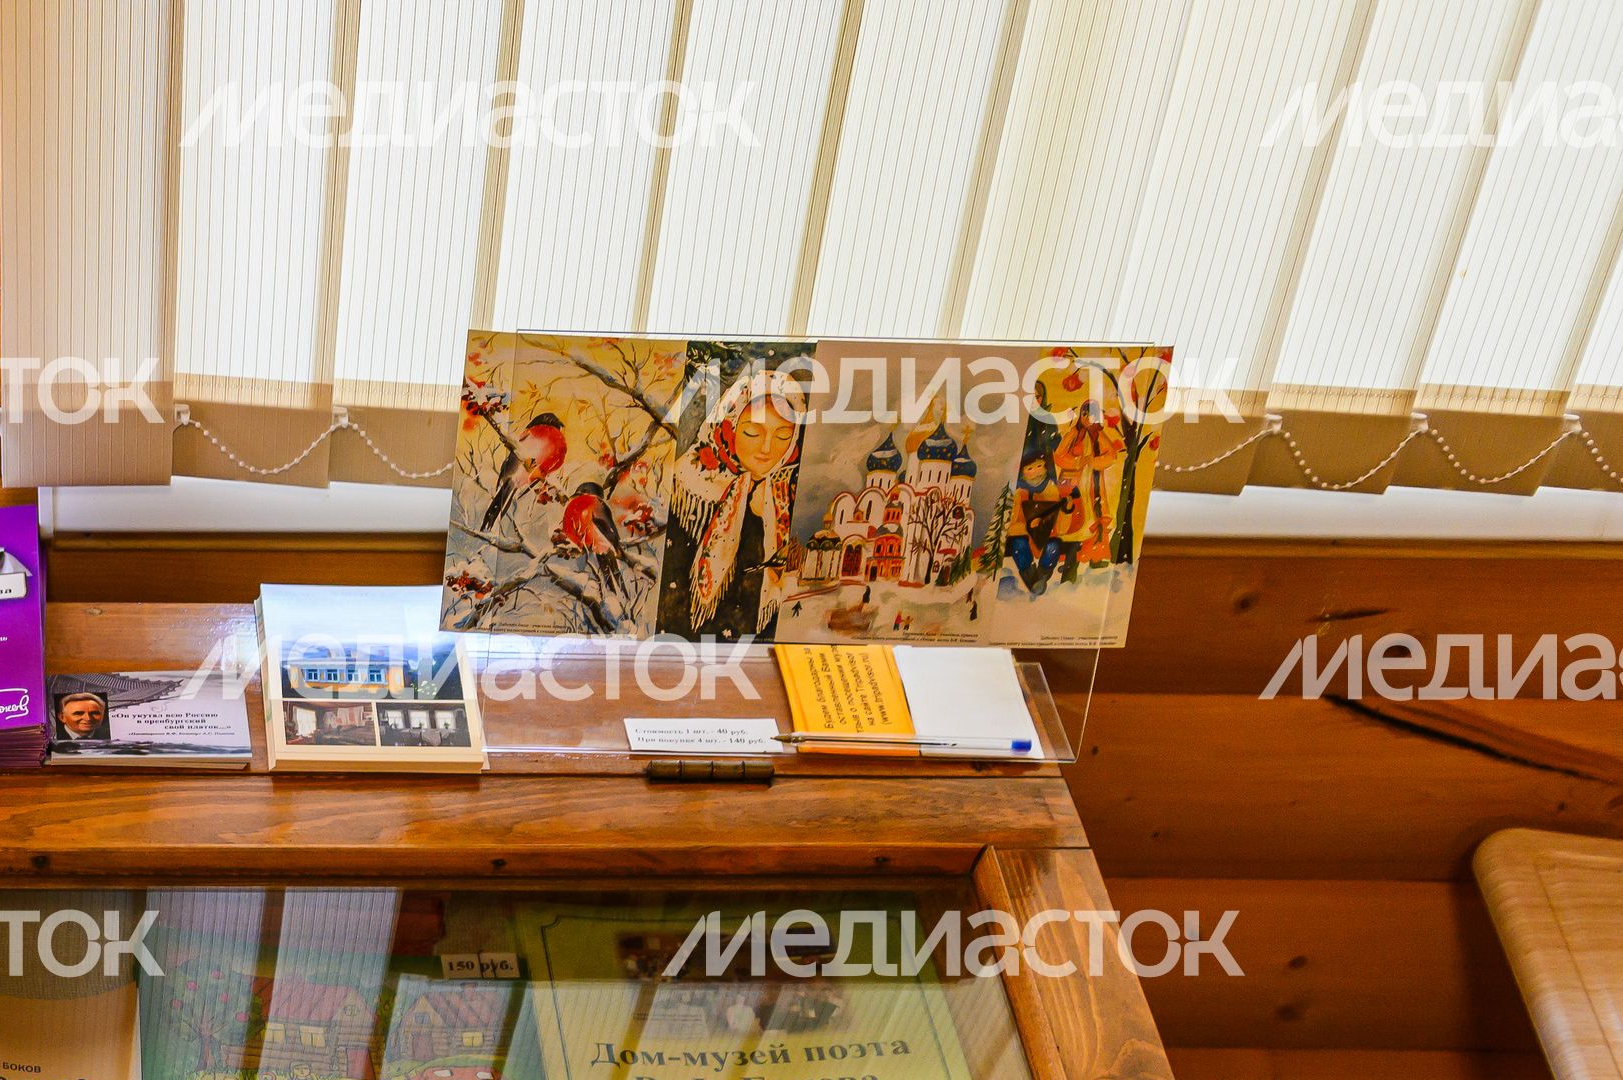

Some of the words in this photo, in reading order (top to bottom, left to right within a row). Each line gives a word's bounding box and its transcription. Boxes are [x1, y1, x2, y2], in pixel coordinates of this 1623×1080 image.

[447, 960, 475, 973] 150
[591, 1041, 792, 1074] Дом-музей
[805, 1035, 911, 1063] поэта
[2, 1061, 42, 1074] БОКОВ
